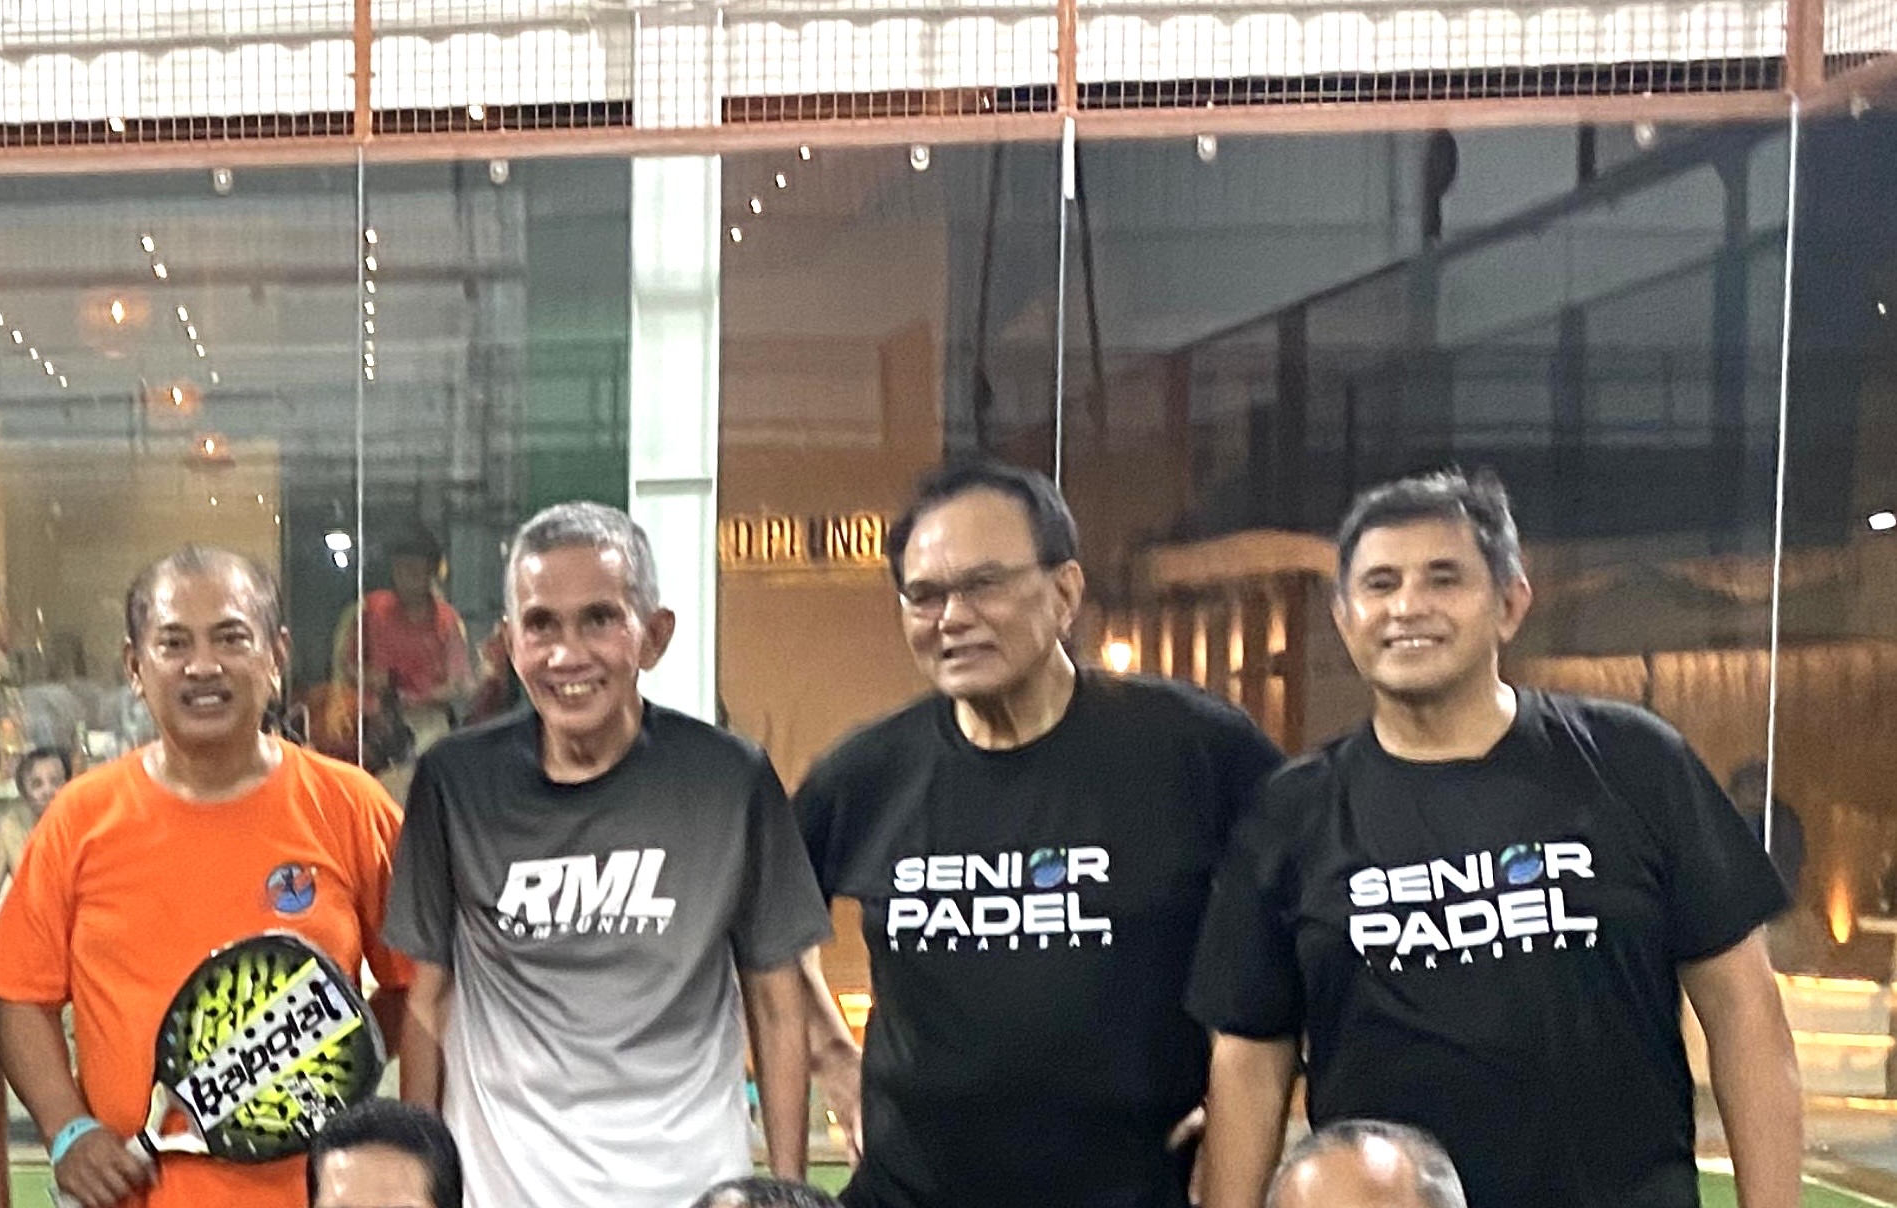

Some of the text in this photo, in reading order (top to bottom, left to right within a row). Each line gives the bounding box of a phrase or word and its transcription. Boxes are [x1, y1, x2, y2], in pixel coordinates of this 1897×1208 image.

[497, 848, 676, 925] RML
[893, 846, 1110, 892] SENIOR
[1349, 842, 1595, 907] SENIOR
[887, 892, 1112, 938] PADEL
[1349, 887, 1598, 956] PADEL
